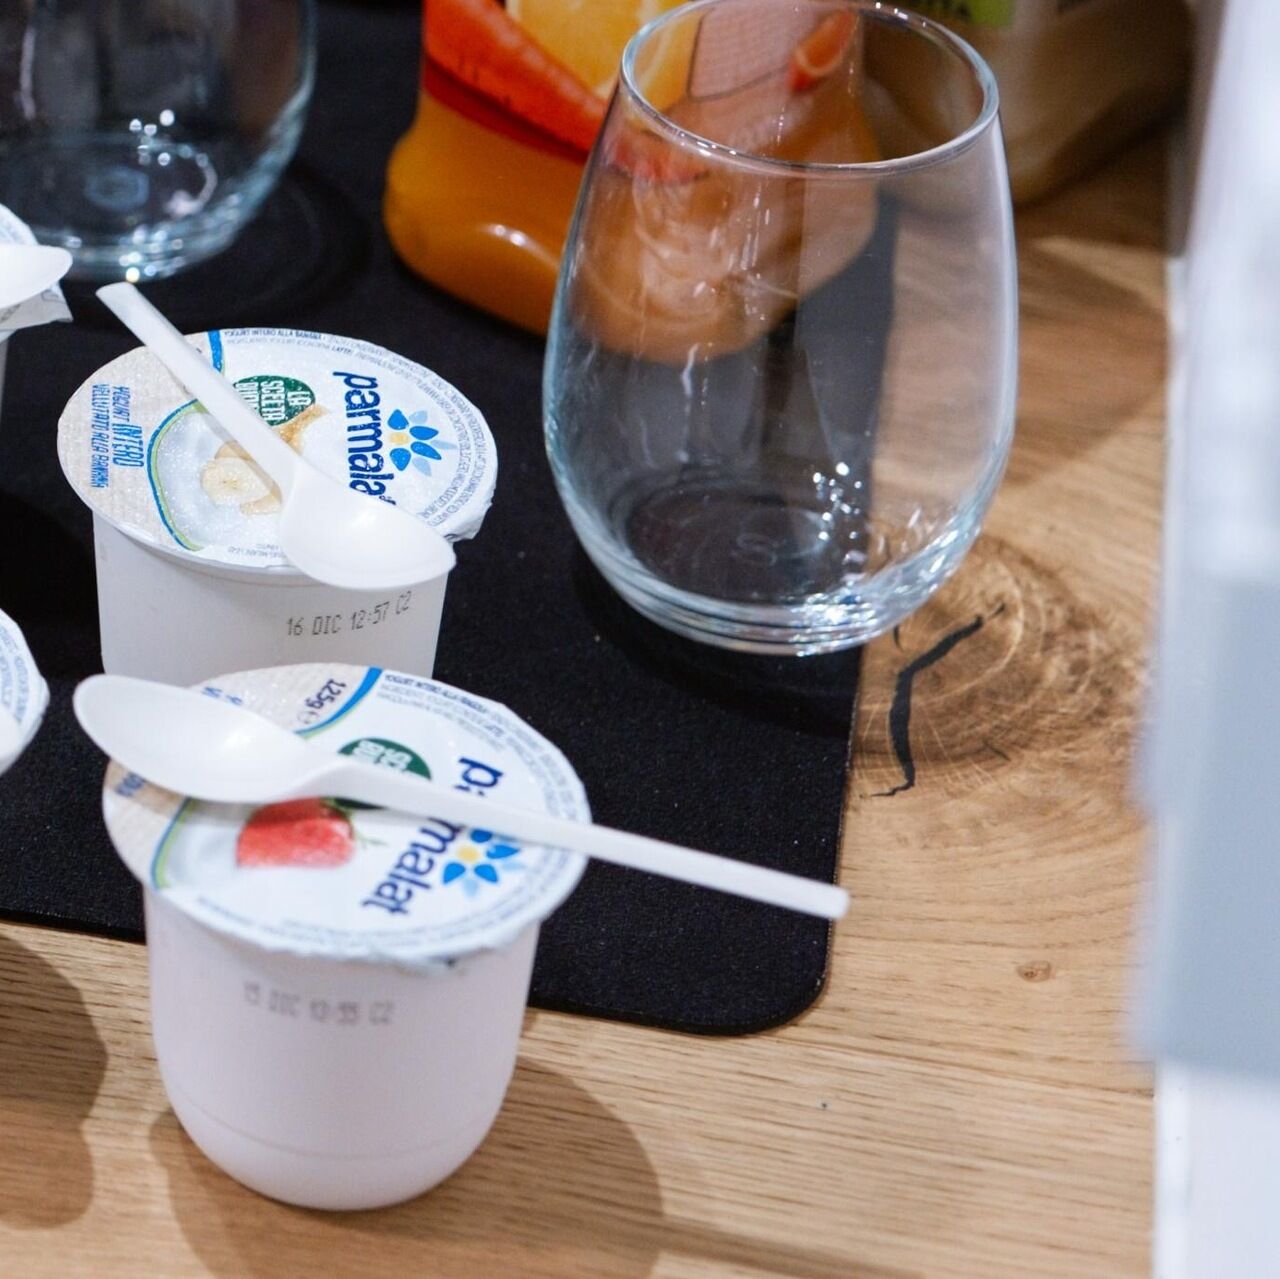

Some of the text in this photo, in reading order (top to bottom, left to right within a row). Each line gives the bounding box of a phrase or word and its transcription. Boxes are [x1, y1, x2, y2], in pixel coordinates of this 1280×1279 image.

[91, 383, 110, 431] VELLUTATO
[236, 382, 259, 410] BUO
[260, 380, 286, 421] SCELTA
[287, 390, 312, 406] LA
[91, 431, 109, 453] ALLA
[111, 385, 145, 468] YOGURT INTERO
[286, 616, 304, 636] 16
[311, 613, 342, 635] DIC
[350, 600, 390, 631] 12:57
[305, 677, 348, 711] 125g
[361, 756, 504, 915] pmalat
